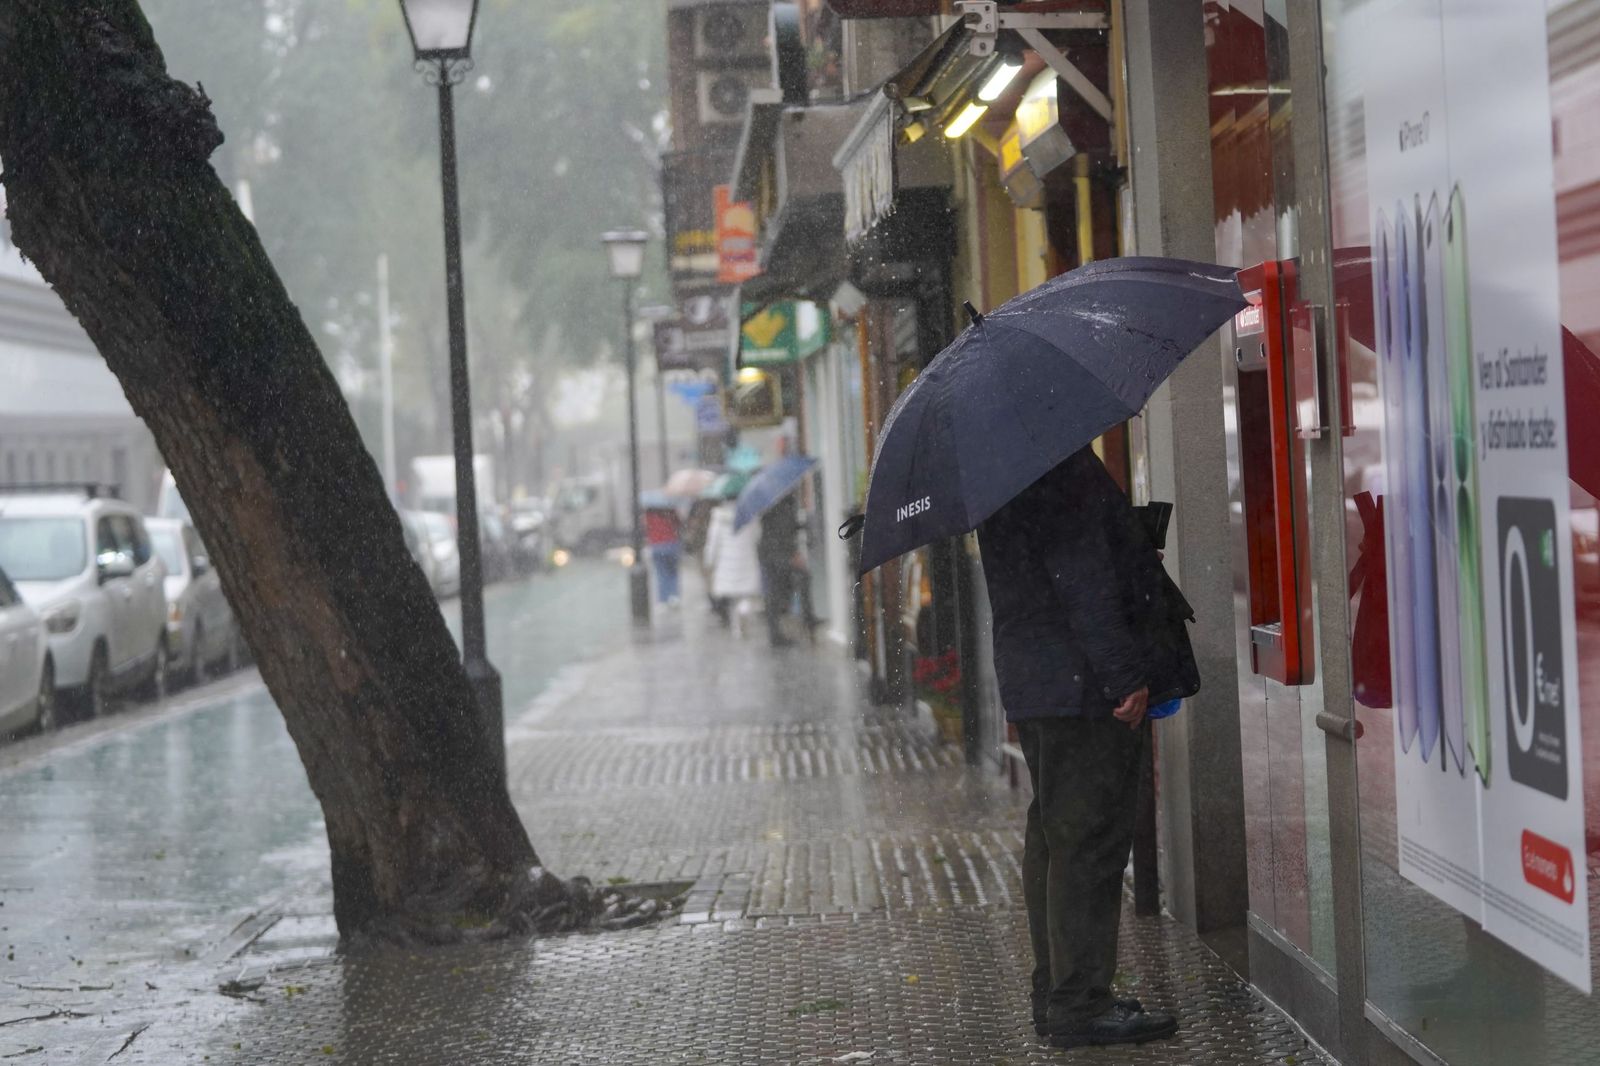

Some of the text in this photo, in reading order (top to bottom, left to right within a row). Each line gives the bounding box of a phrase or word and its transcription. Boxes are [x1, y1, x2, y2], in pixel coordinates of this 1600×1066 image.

[1477, 352, 1494, 389] Ven
[1503, 344, 1548, 388] Santander
[1480, 422, 1487, 460] y
[897, 496, 931, 522] INESIS
[1505, 525, 1535, 753] 0
